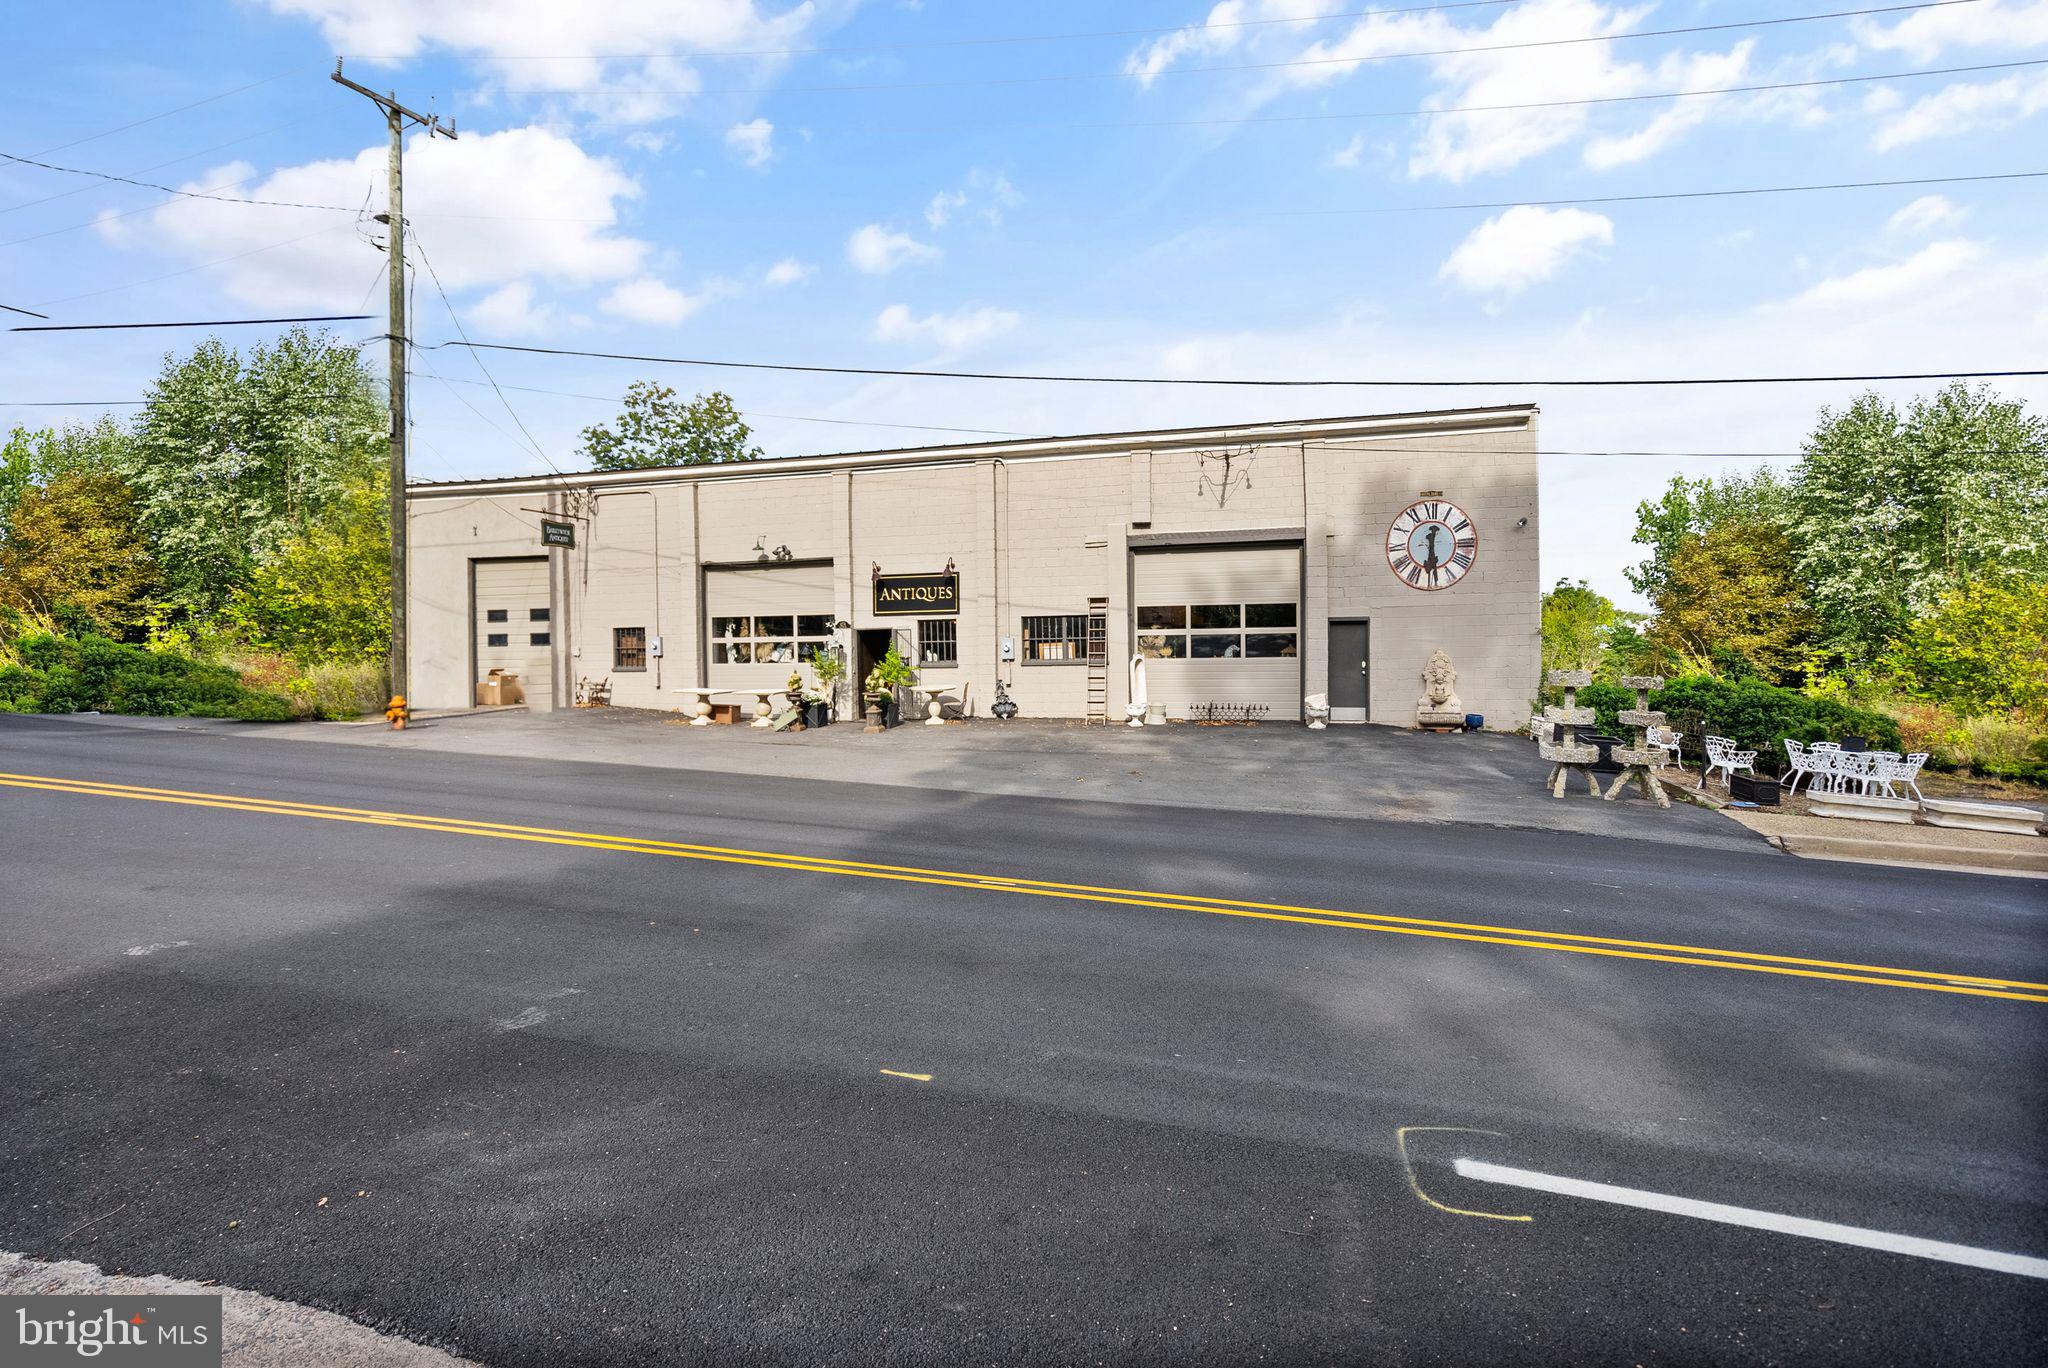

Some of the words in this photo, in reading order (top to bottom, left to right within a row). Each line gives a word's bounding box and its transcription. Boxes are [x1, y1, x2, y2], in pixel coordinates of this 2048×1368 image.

[1406, 508, 1421, 525] XI
[1424, 503, 1438, 519] XII
[1443, 506, 1453, 522] I
[1393, 523, 1410, 536] X
[1452, 518, 1470, 533] II
[1457, 537, 1475, 548] III
[880, 586, 953, 602] ANTIQUES
